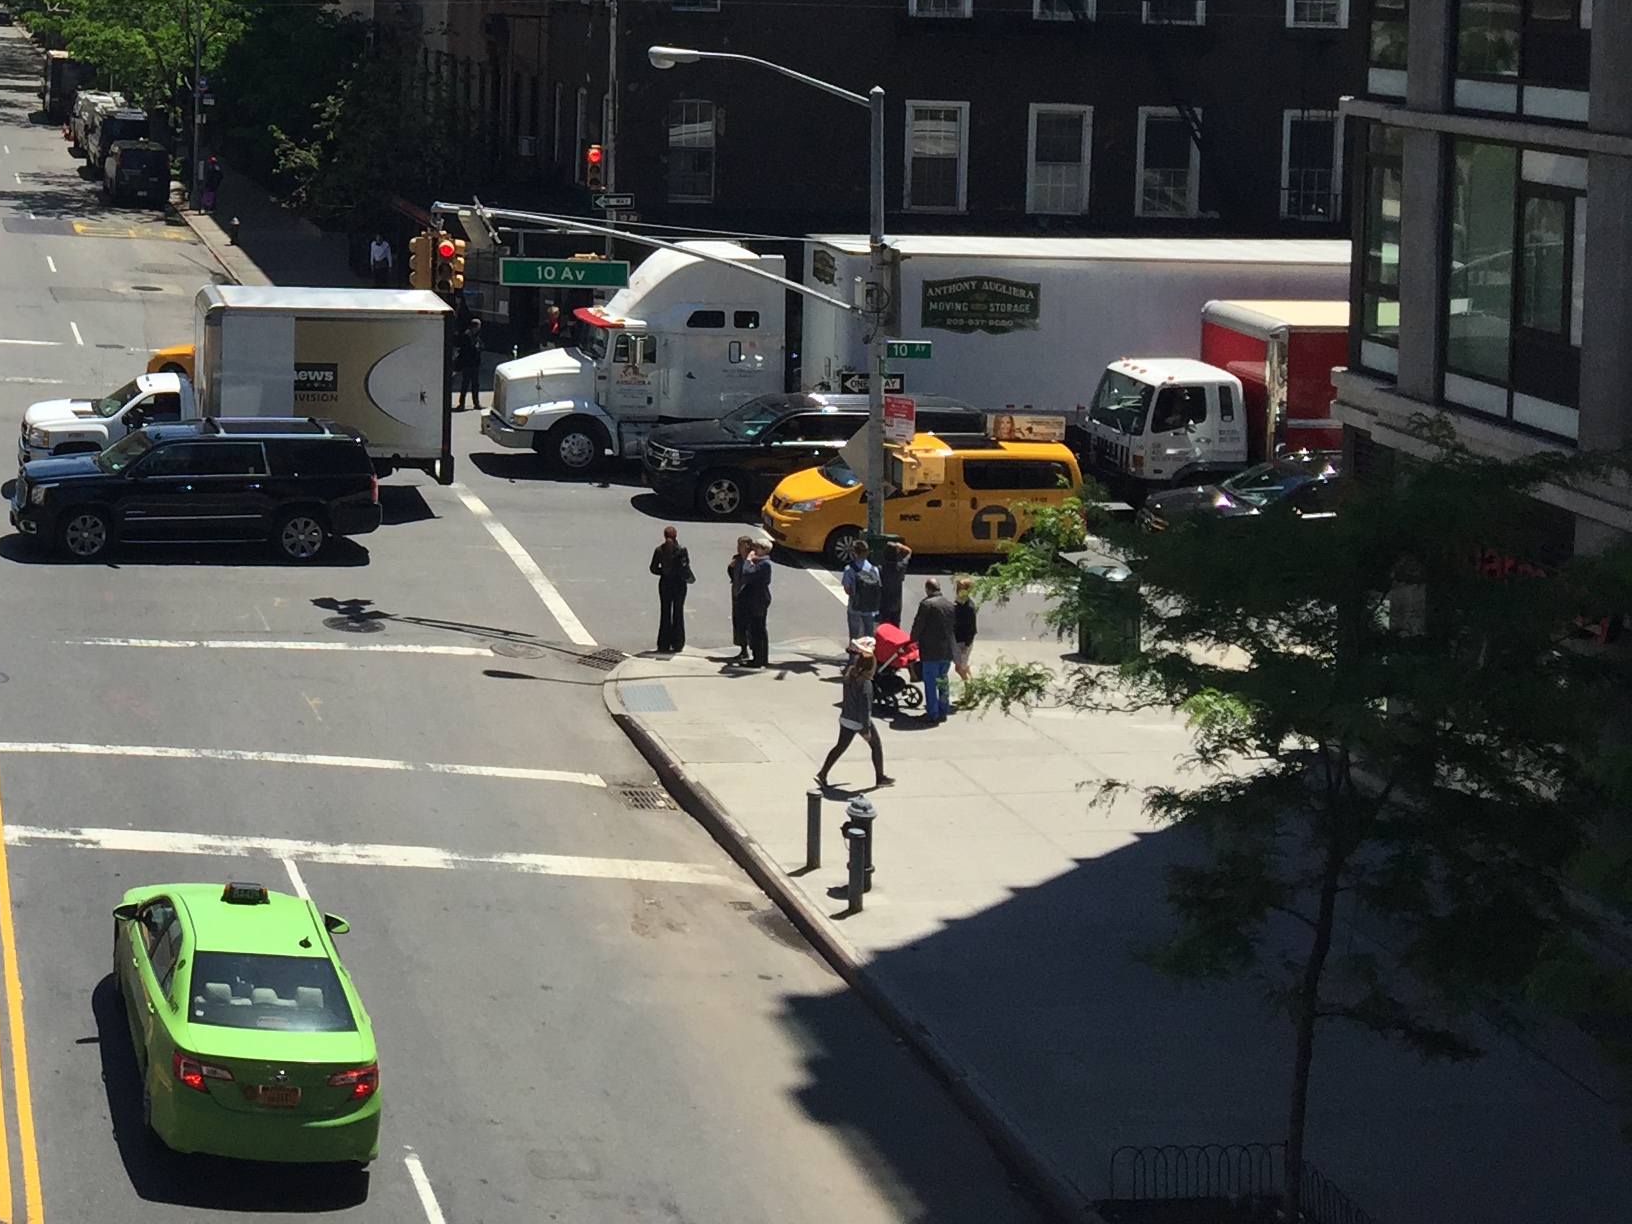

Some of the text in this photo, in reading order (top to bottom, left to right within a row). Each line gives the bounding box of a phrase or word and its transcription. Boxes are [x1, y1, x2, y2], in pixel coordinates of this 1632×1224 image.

[536, 265, 586, 281] 10 Av
[926, 280, 1035, 299] ANTHONY AUGLIERA
[928, 301, 1032, 313] MOVING STORAGE
[893, 343, 908, 357] 10
[850, 379, 897, 389] ONE AY
[294, 393, 338, 403] IVISION
[899, 513, 921, 522] NYC
